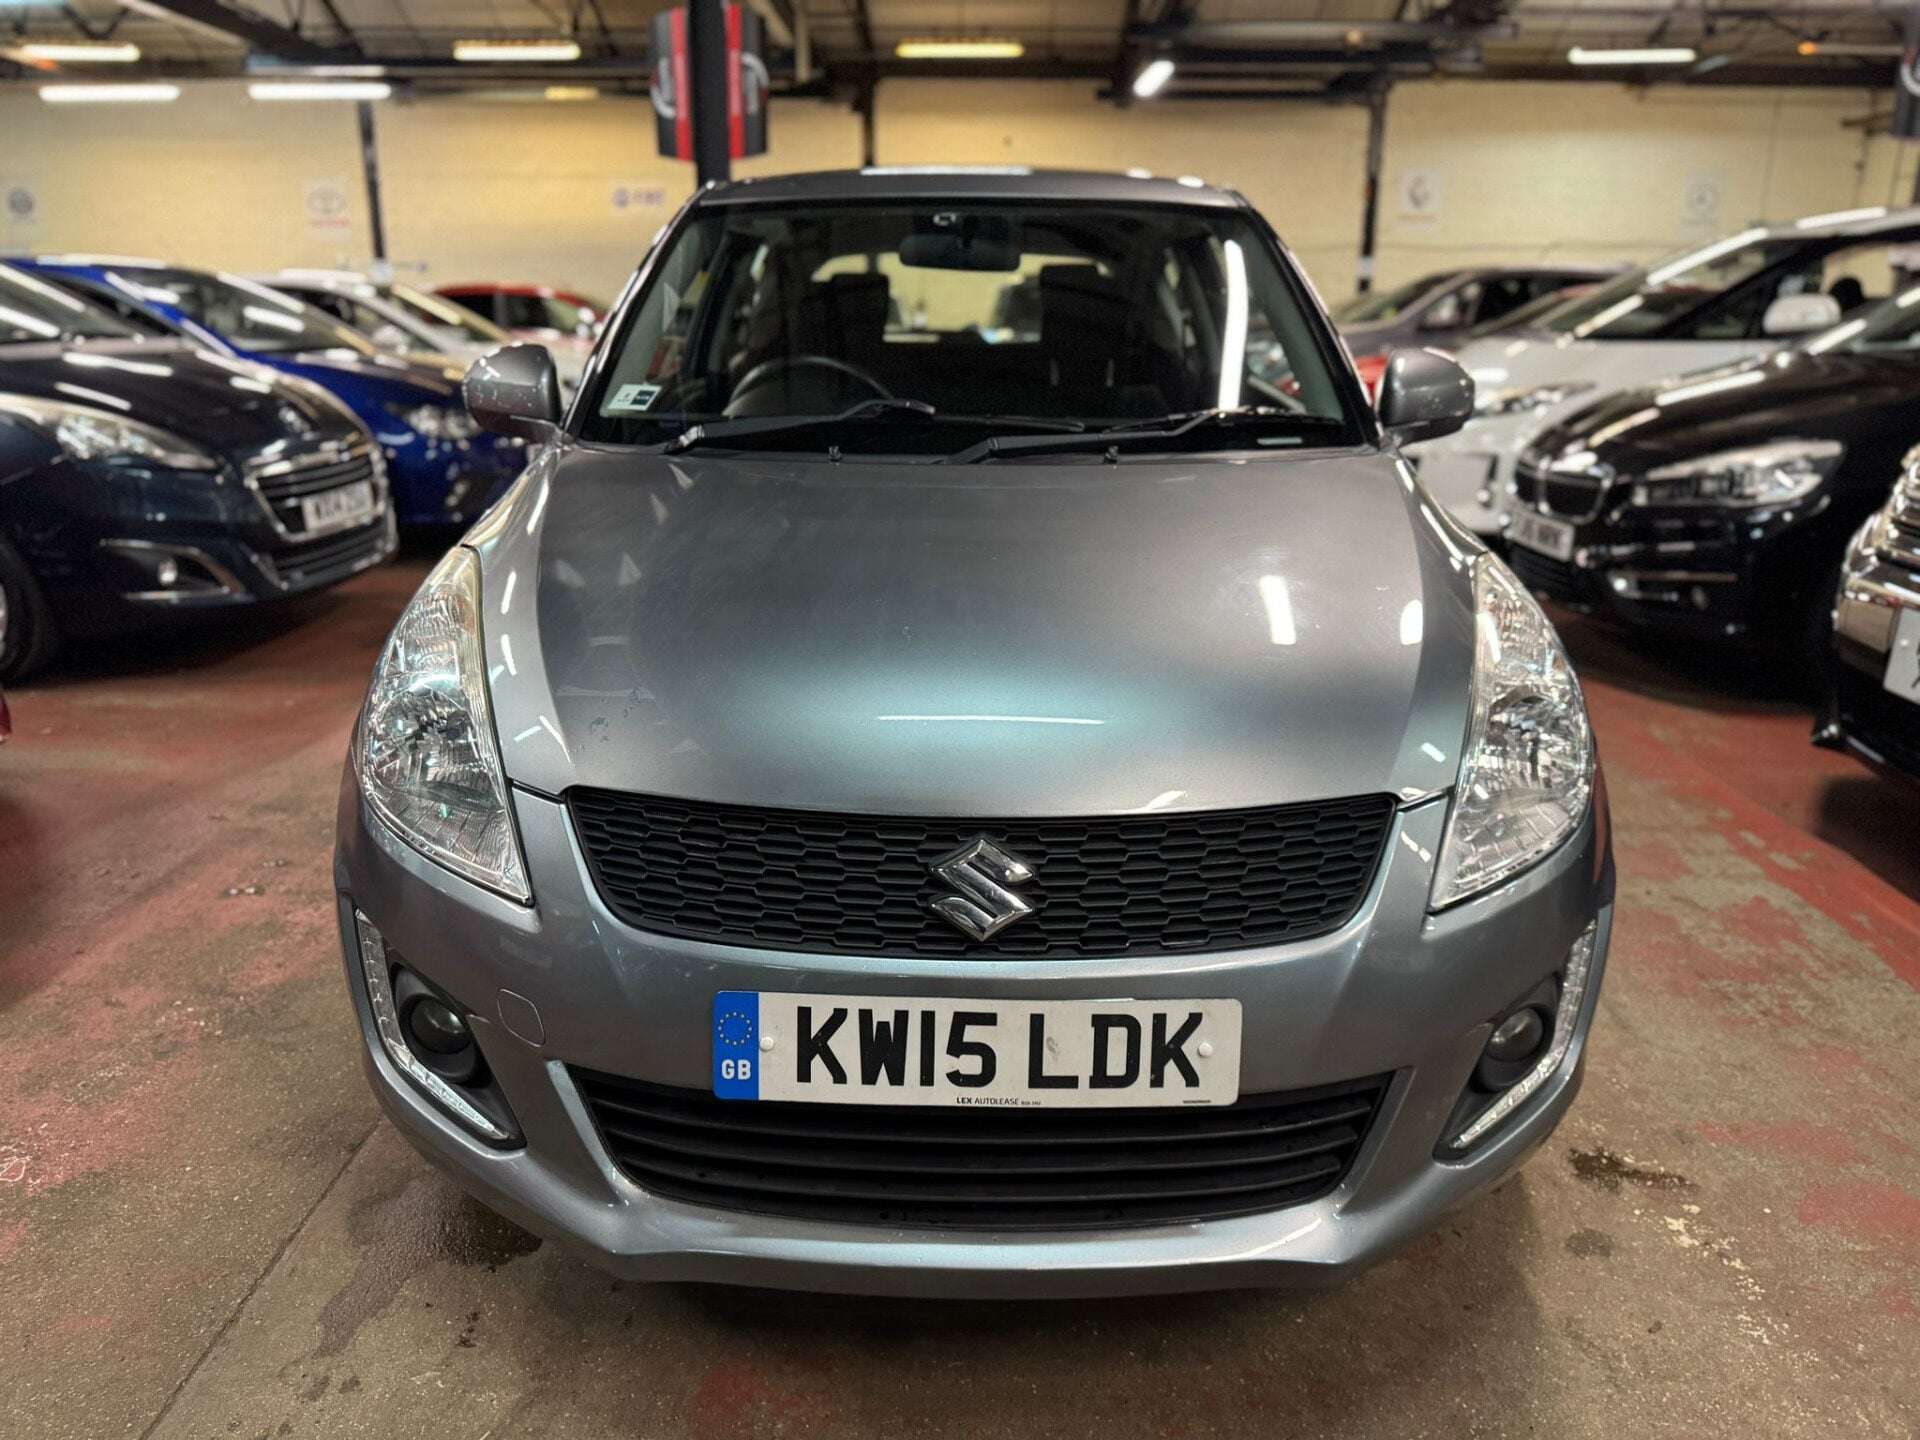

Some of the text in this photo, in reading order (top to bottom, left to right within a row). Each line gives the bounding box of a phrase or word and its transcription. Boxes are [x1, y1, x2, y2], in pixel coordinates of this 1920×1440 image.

[796, 1005, 1203, 1089] KW15 LDK
[721, 1058, 751, 1080] GB
[956, 1096, 972, 1105] LEX
[974, 1096, 1019, 1105] AUTOLEASE
